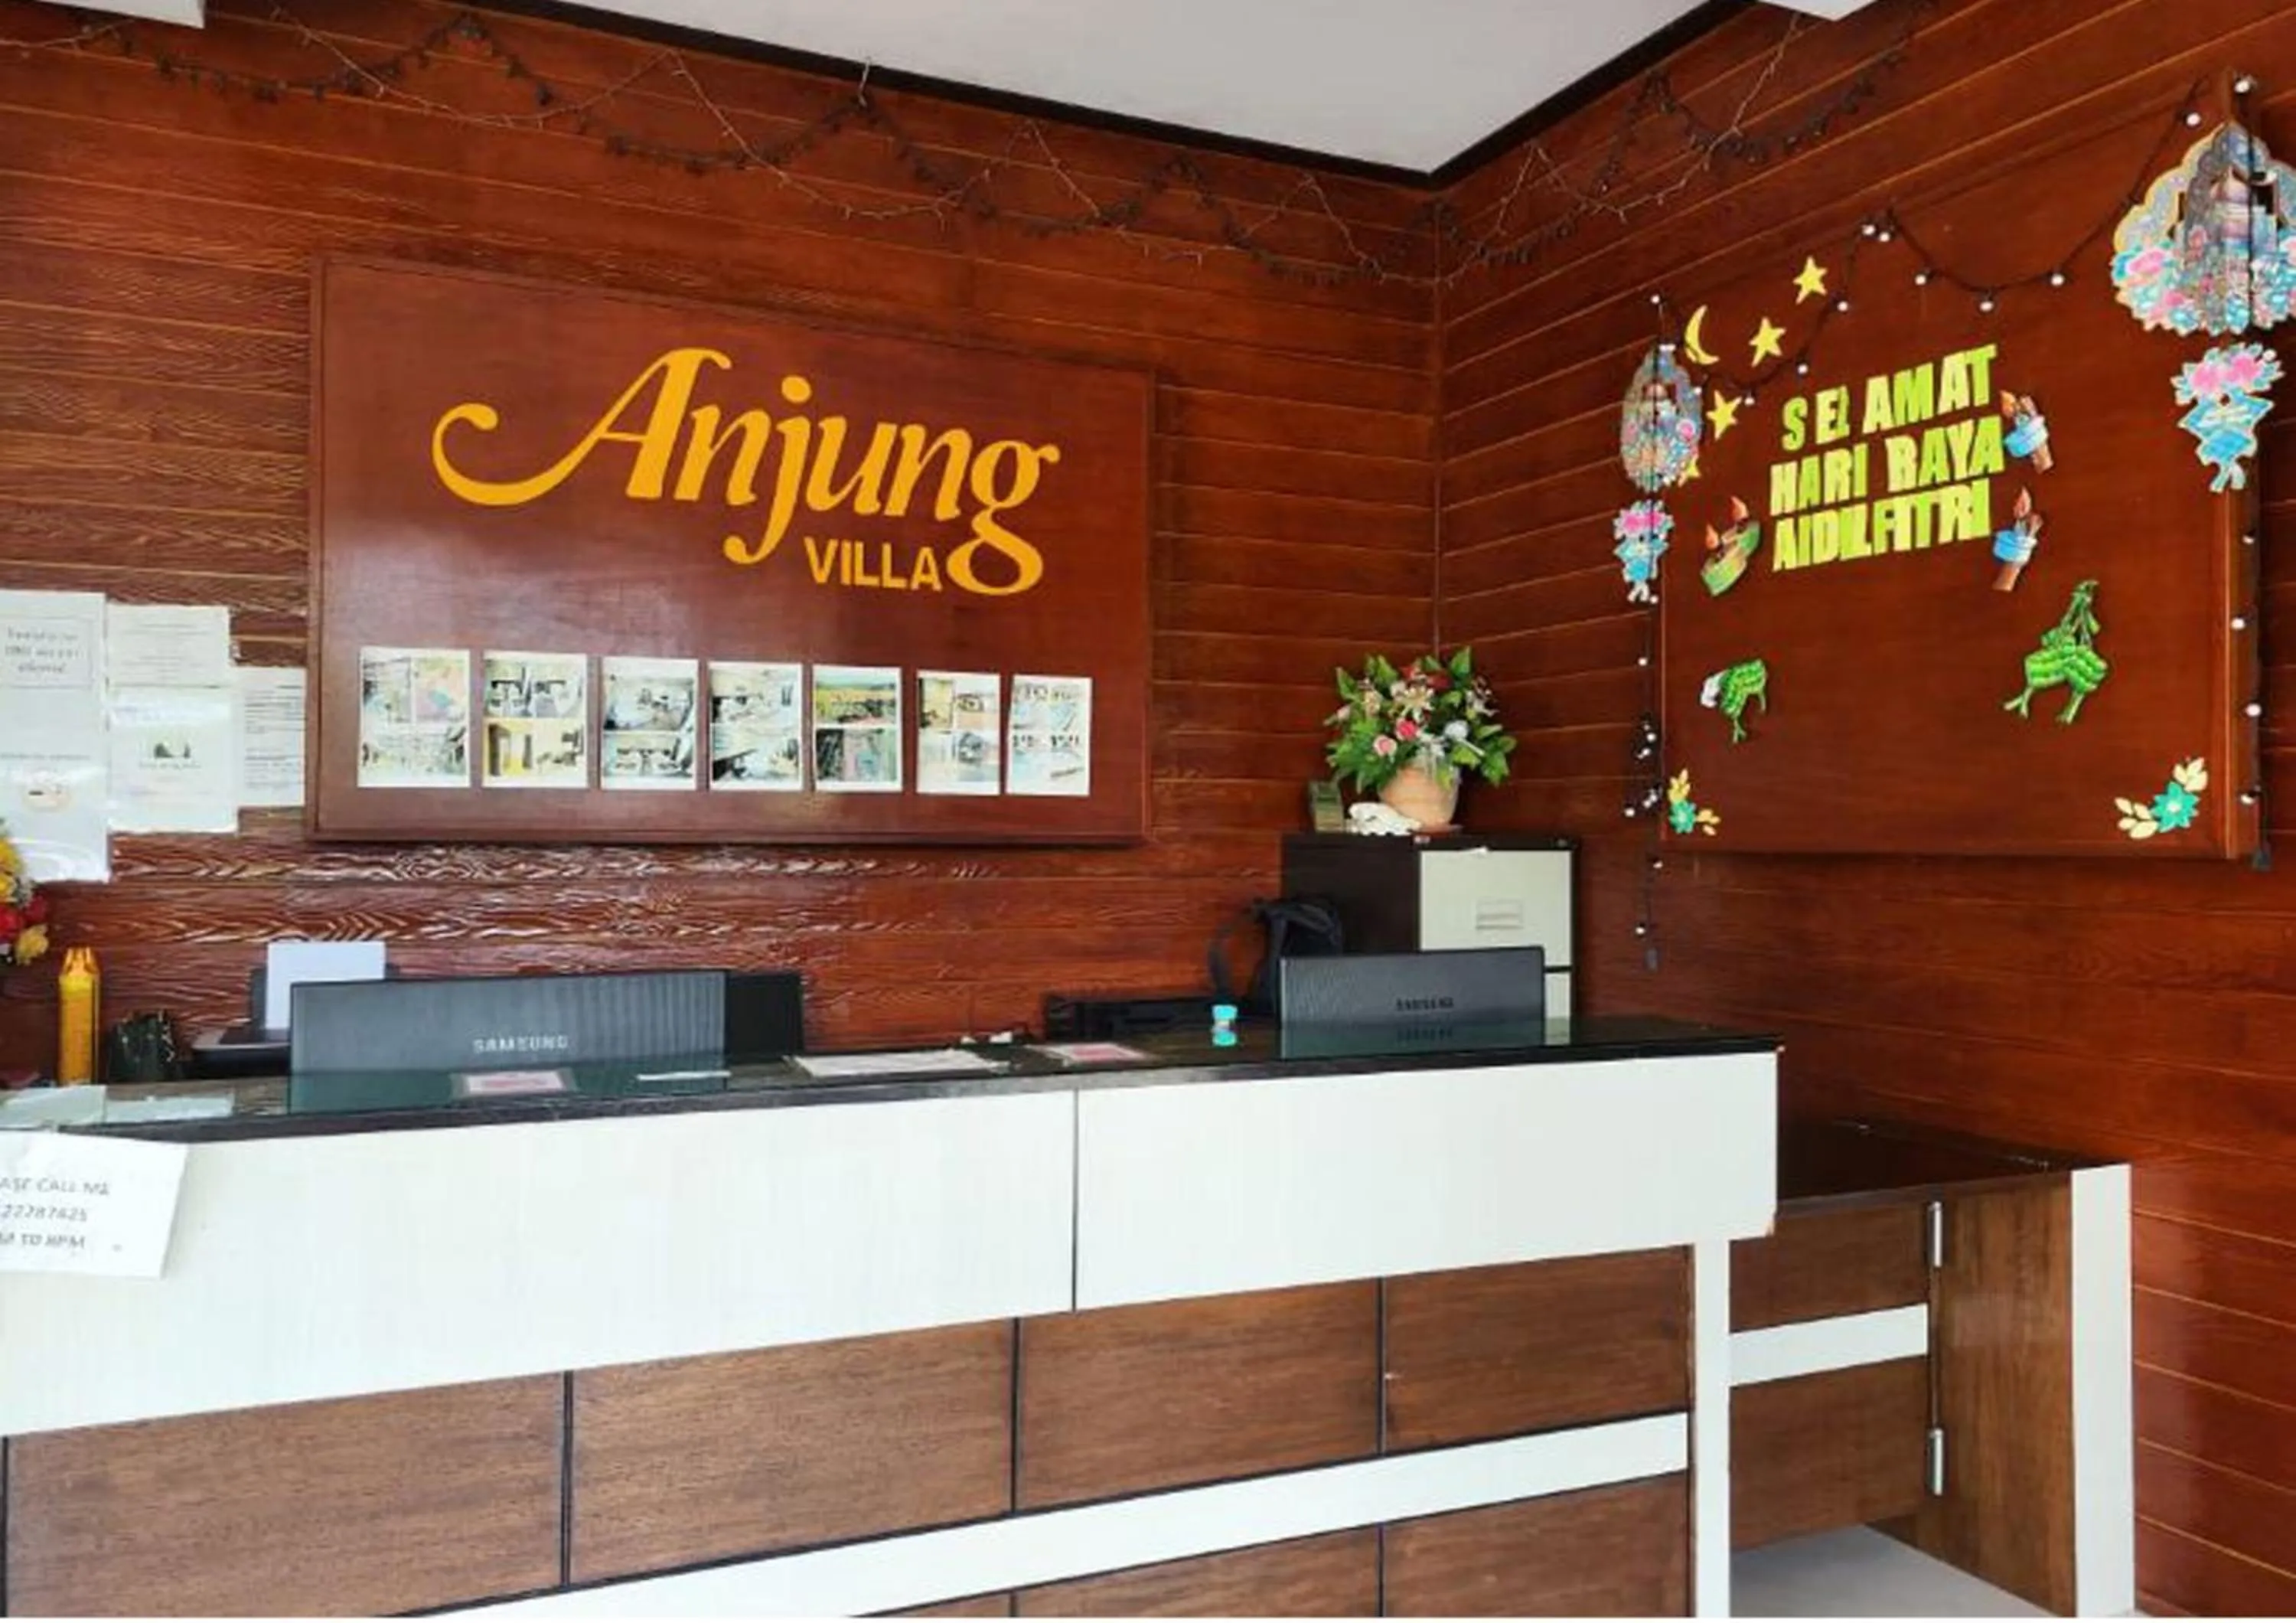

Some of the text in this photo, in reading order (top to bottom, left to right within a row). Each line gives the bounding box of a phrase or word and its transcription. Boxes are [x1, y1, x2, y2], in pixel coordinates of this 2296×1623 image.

[431, 347, 1061, 596] Anjung
[1769, 414, 2006, 517] HARI RAYA
[803, 536, 943, 593] VILLA
[471, 1034, 569, 1053] SAMSUNG
